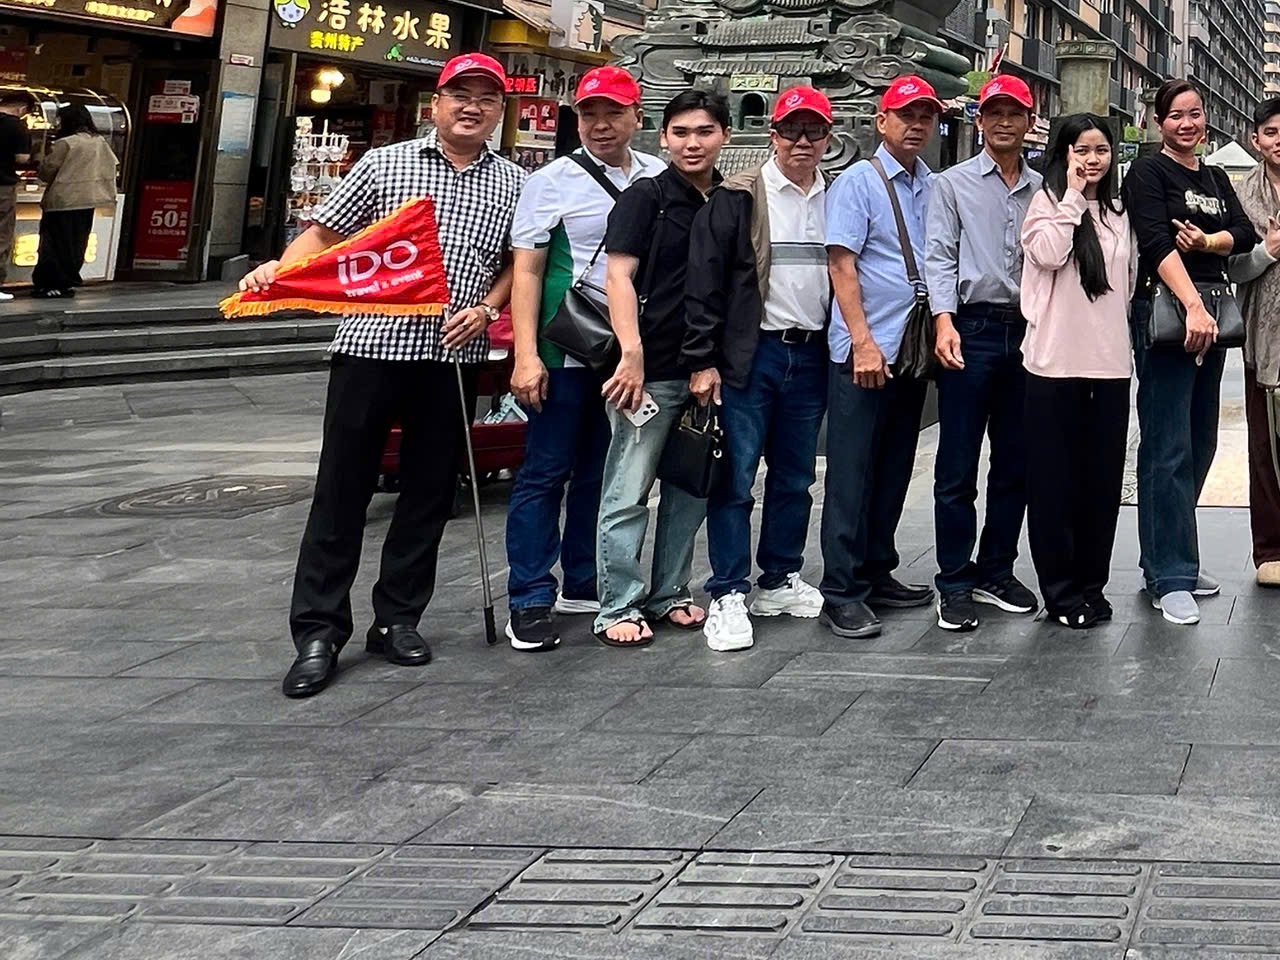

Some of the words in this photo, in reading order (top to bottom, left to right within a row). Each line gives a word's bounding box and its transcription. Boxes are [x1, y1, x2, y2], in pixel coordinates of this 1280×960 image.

[309, 30, 365, 52] 贵州特产
[344, 280, 380, 297] travel
